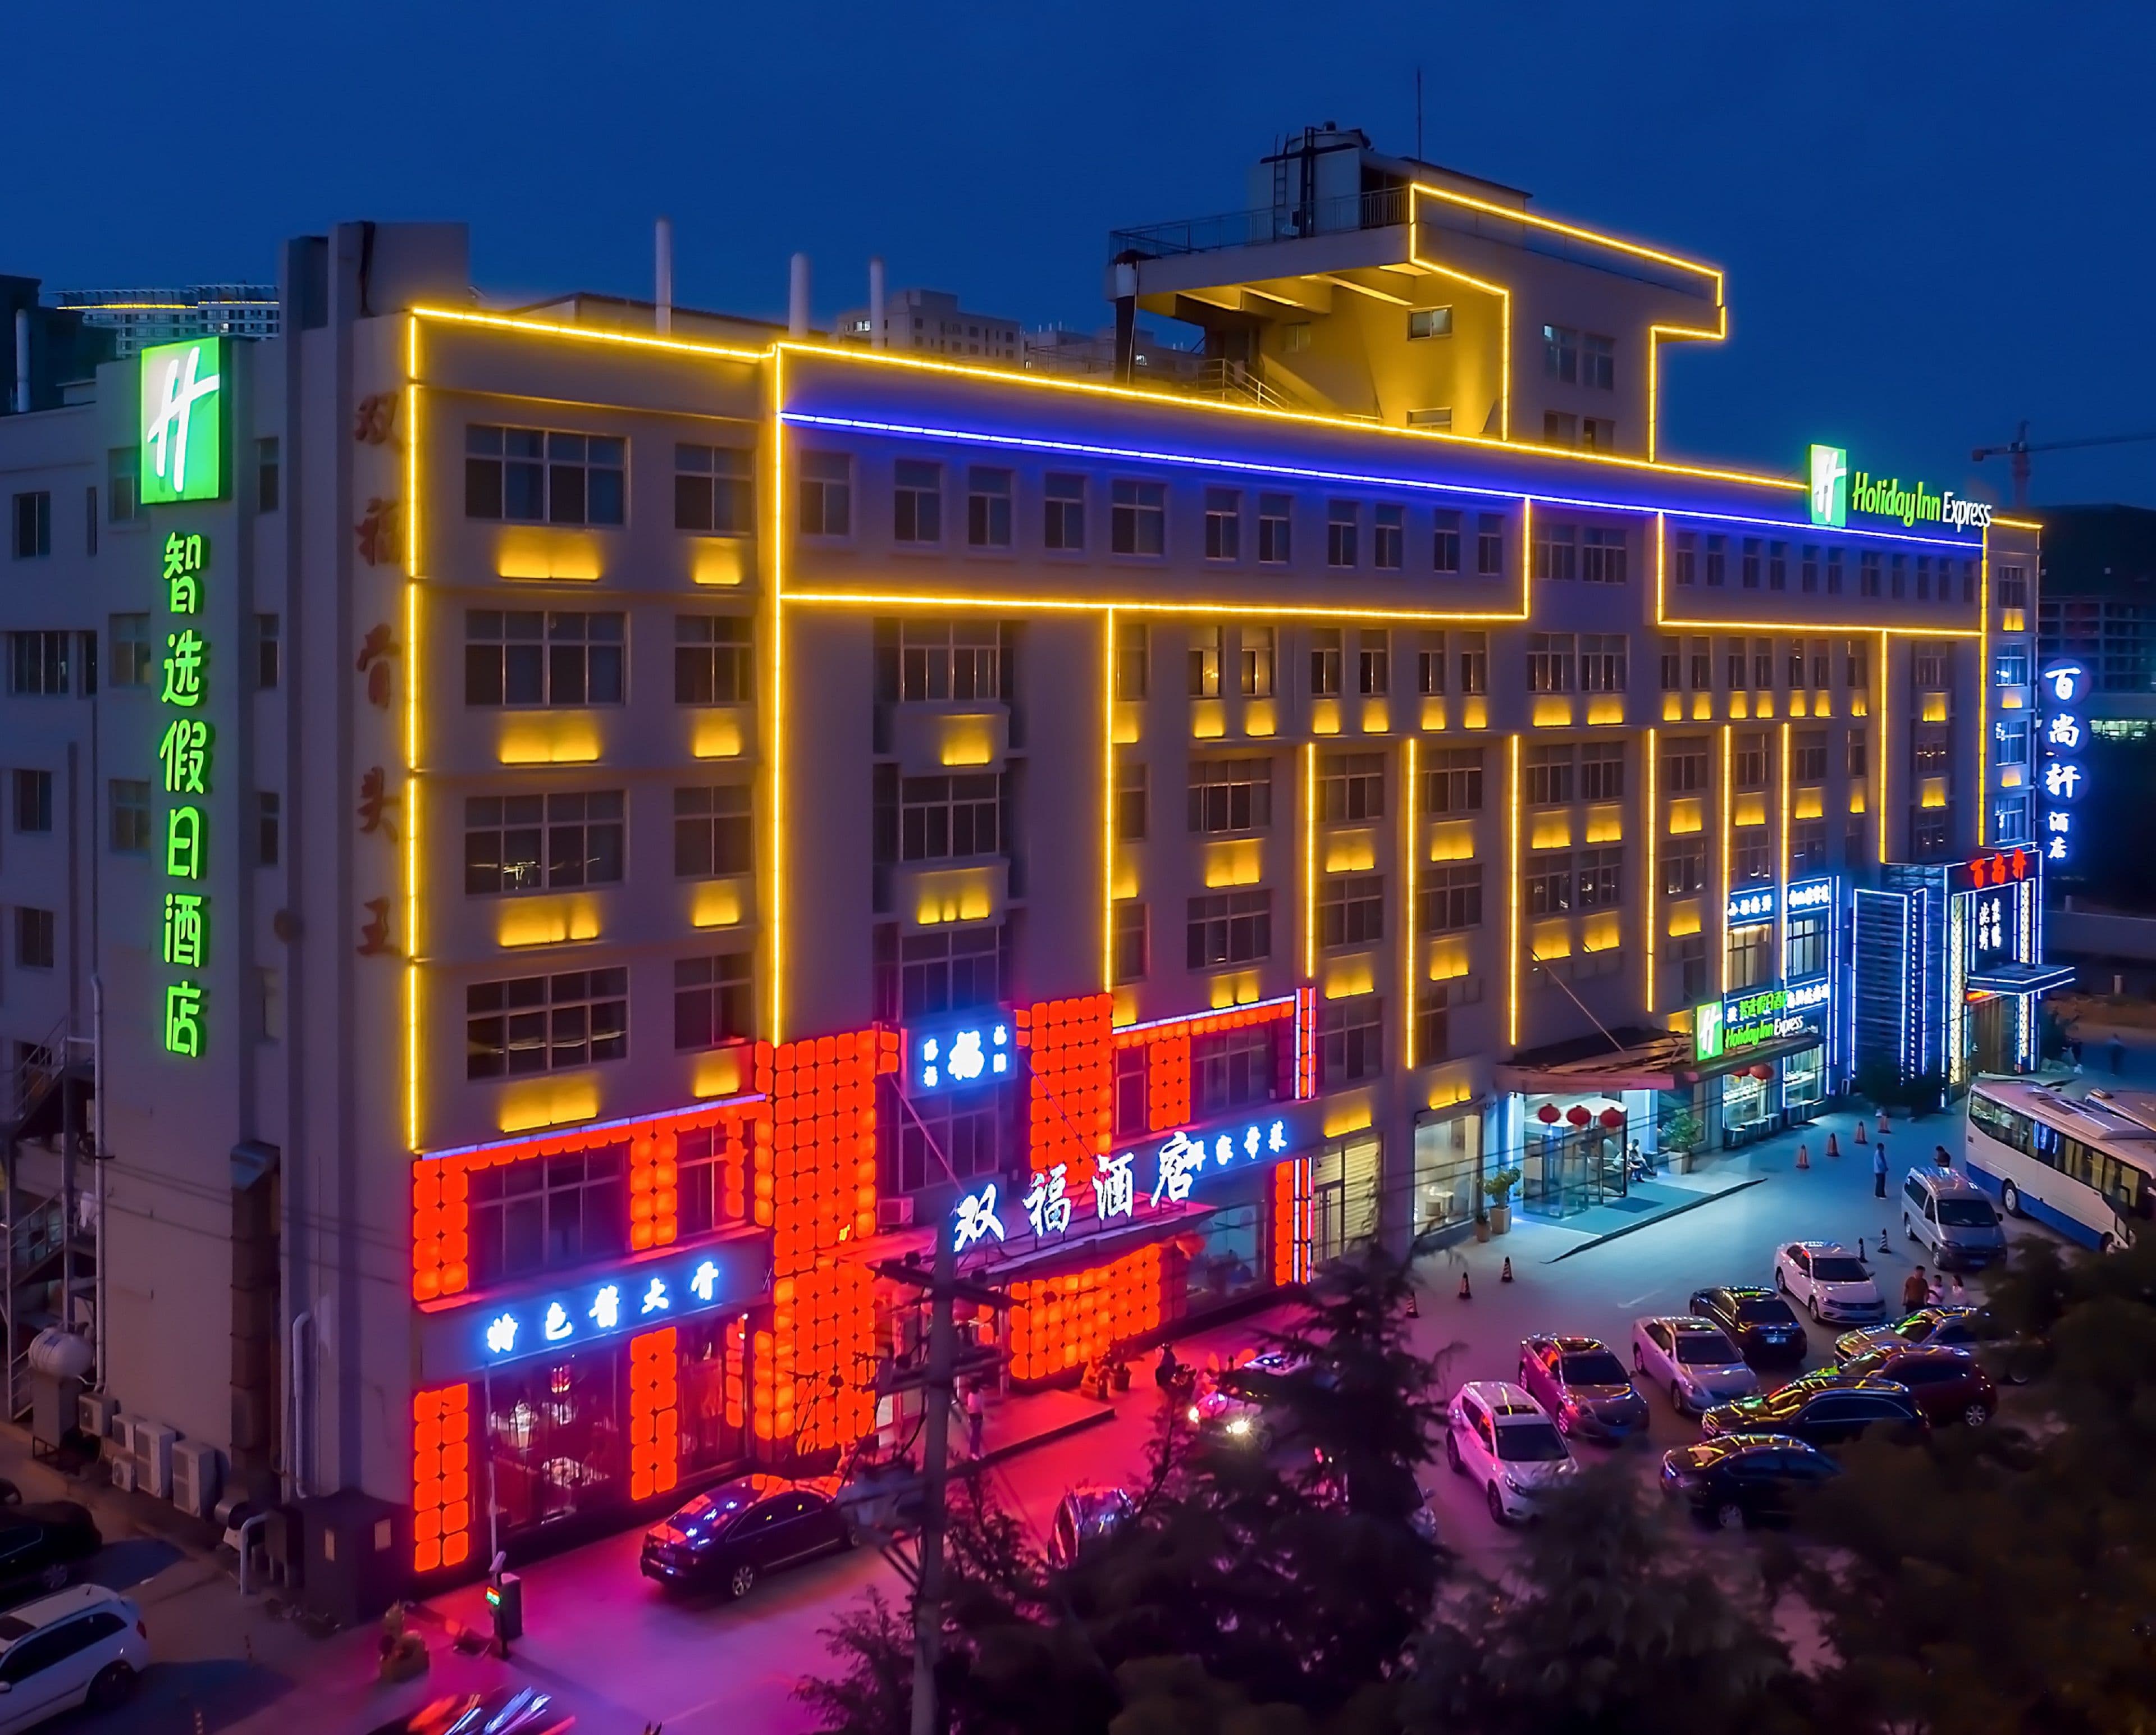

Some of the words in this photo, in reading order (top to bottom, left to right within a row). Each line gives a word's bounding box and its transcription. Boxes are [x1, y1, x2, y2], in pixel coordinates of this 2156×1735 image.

[1943, 491, 1992, 533] Express
[159, 531, 205, 1058] 智选假日酒店
[1774, 1015, 1805, 1038] Express
[954, 1131, 1194, 1252] 双福酒店
